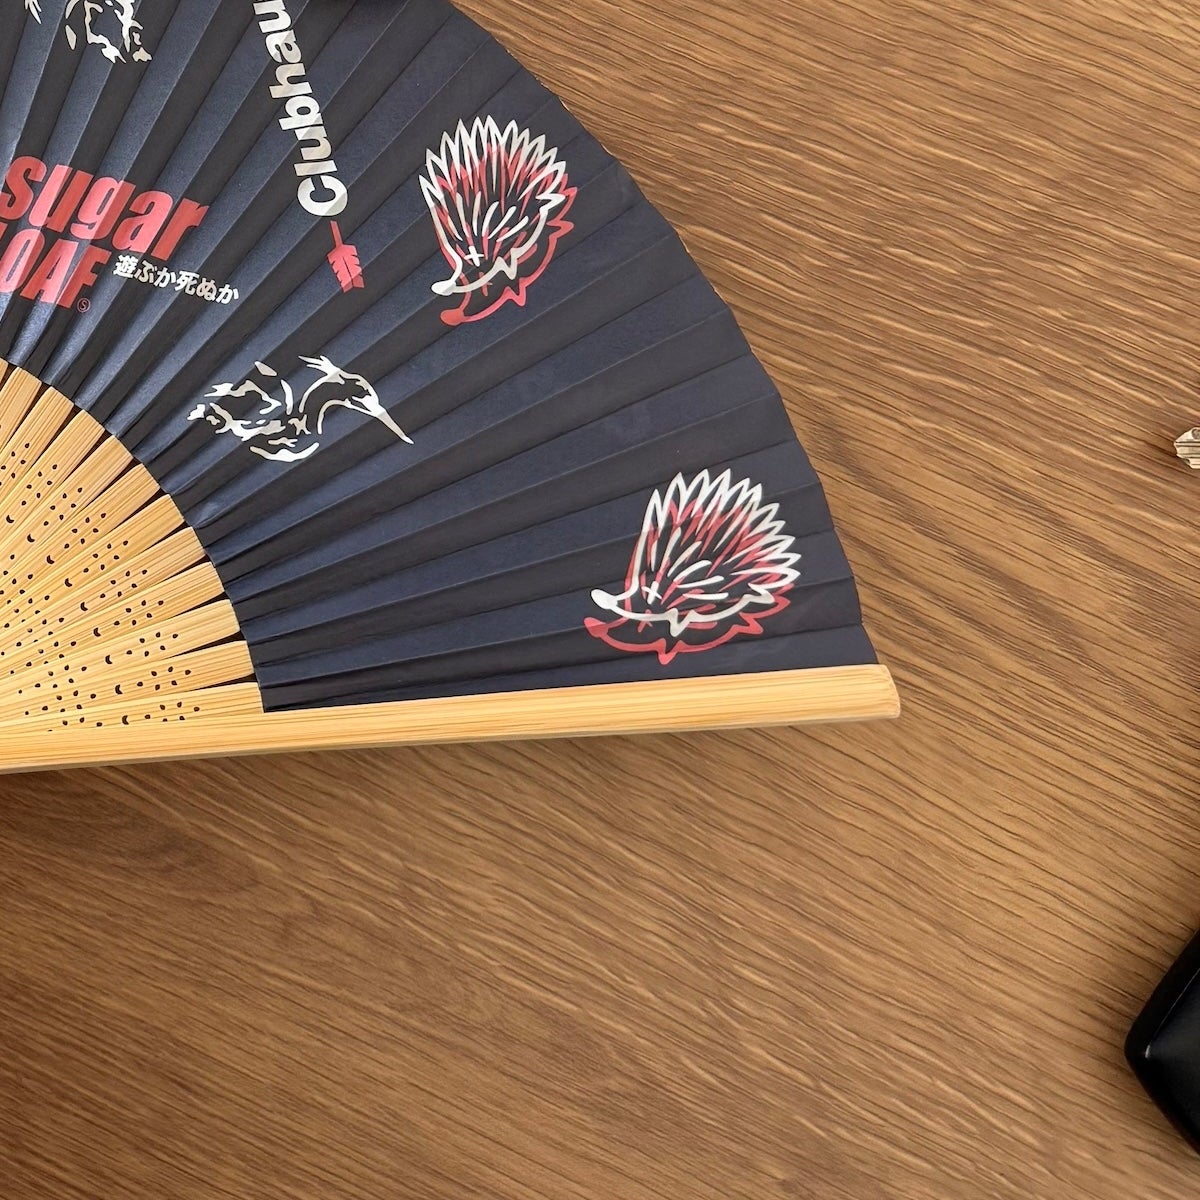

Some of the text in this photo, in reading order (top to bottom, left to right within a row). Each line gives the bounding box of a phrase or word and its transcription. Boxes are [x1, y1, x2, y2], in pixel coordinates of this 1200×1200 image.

[112, 255, 240, 305] 遊ぶか死ぬか
